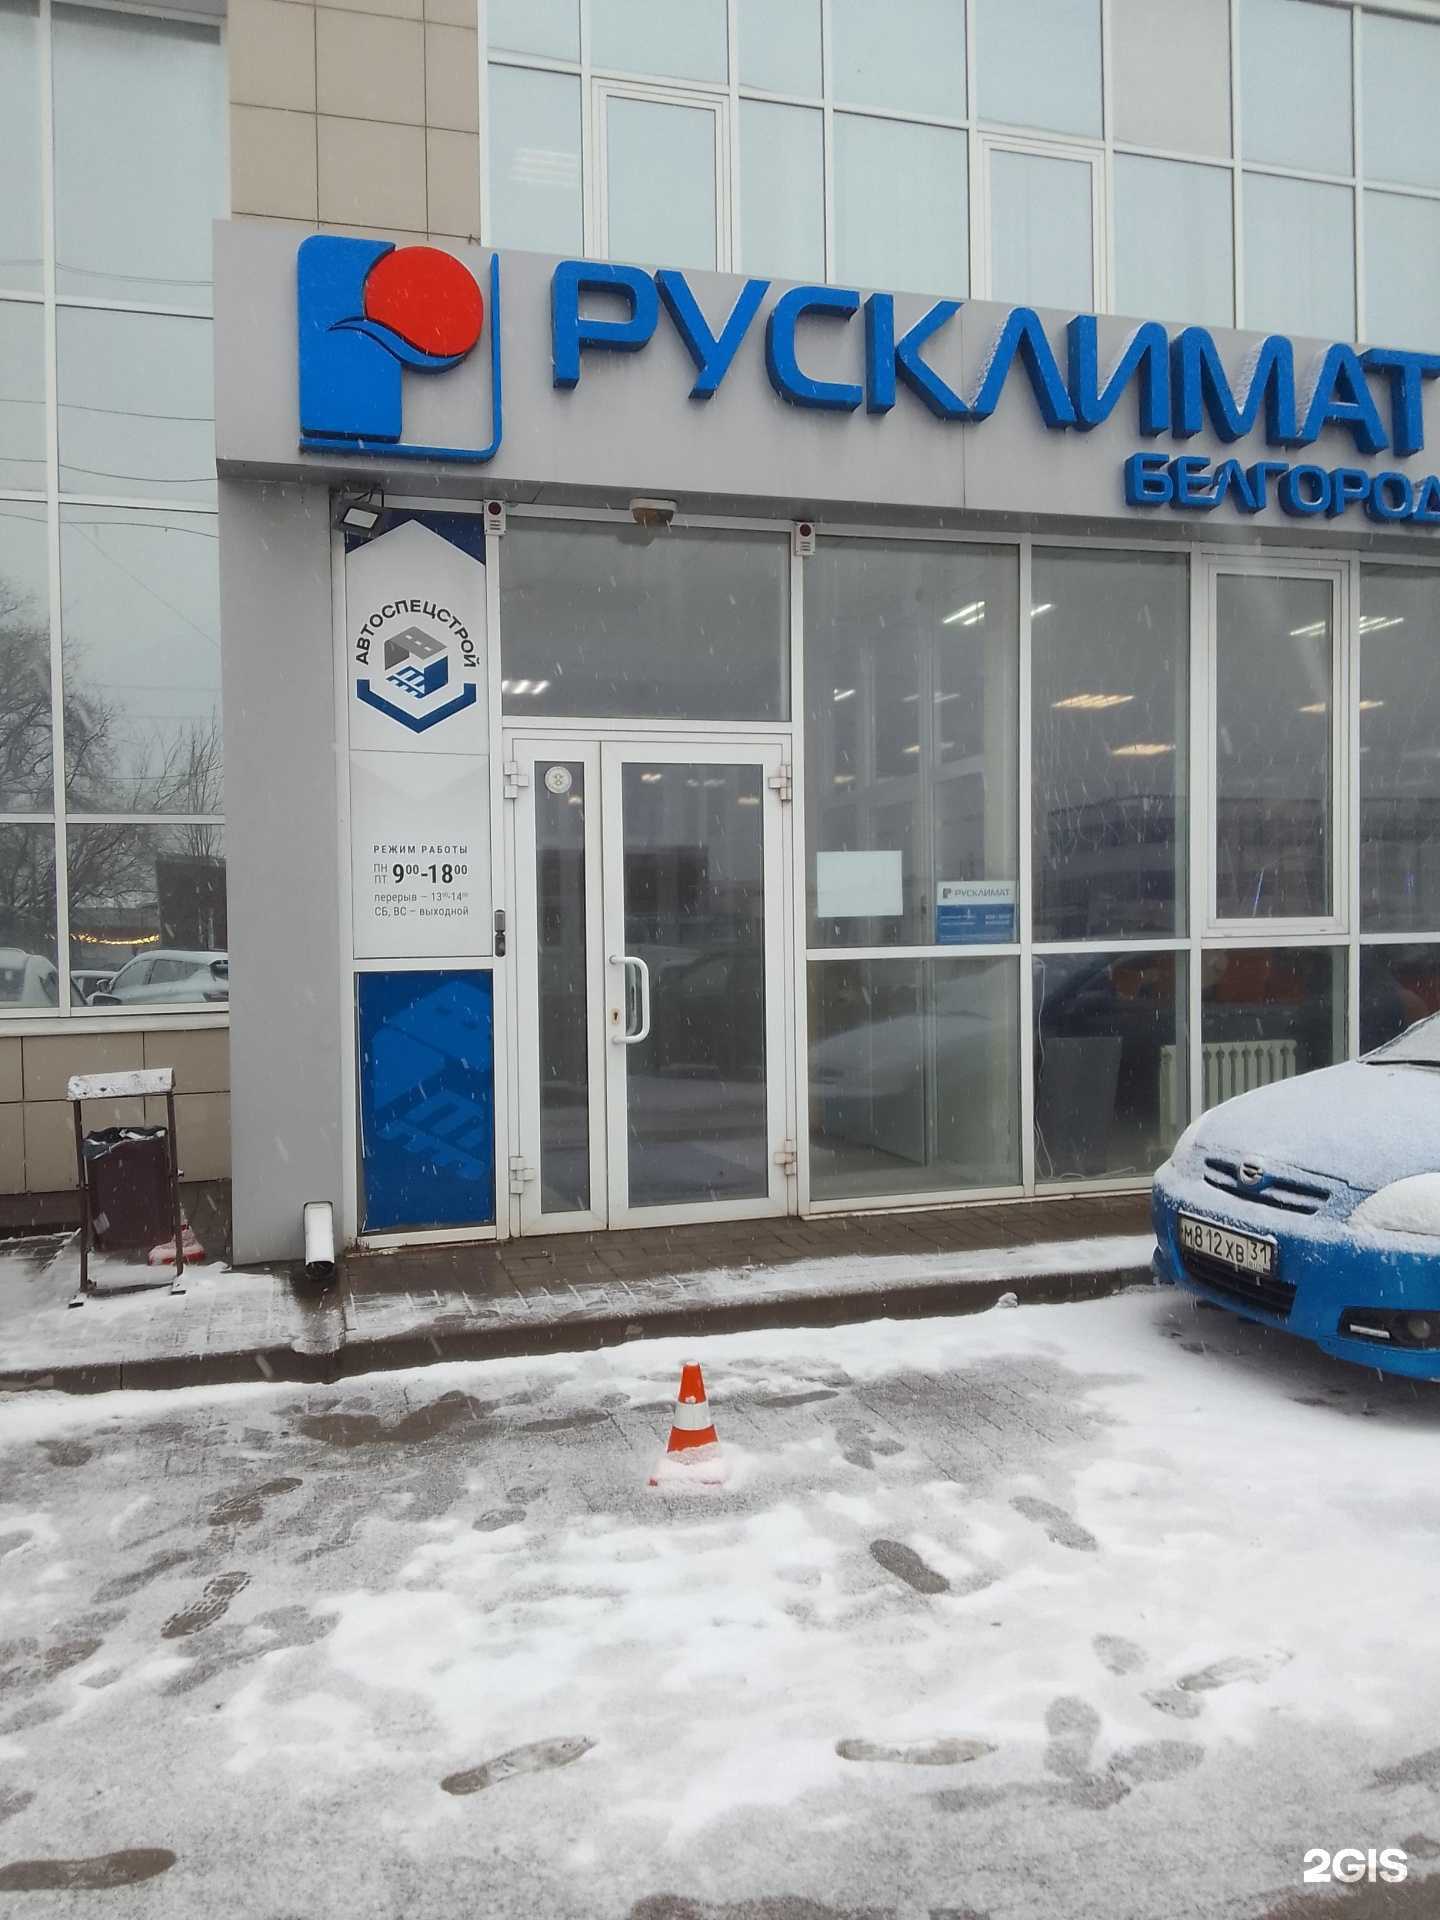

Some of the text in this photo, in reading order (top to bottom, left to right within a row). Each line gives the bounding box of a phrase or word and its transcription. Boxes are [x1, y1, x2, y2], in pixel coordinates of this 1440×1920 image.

[551, 260, 1440, 457] РУСКЛИМАТ
[355, 599, 480, 668] АВТОСПЕЦСТРОЙ
[373, 845, 467, 854] РЕЖИМ РАБОТЫ
[373, 864, 388, 873] ПН
[374, 875, 386, 884] ПТ
[374, 894, 417, 904] перерыв
[374, 906, 391, 917] СБ,
[393, 906, 407, 916] ВС
[419, 906, 468, 917] выходной
